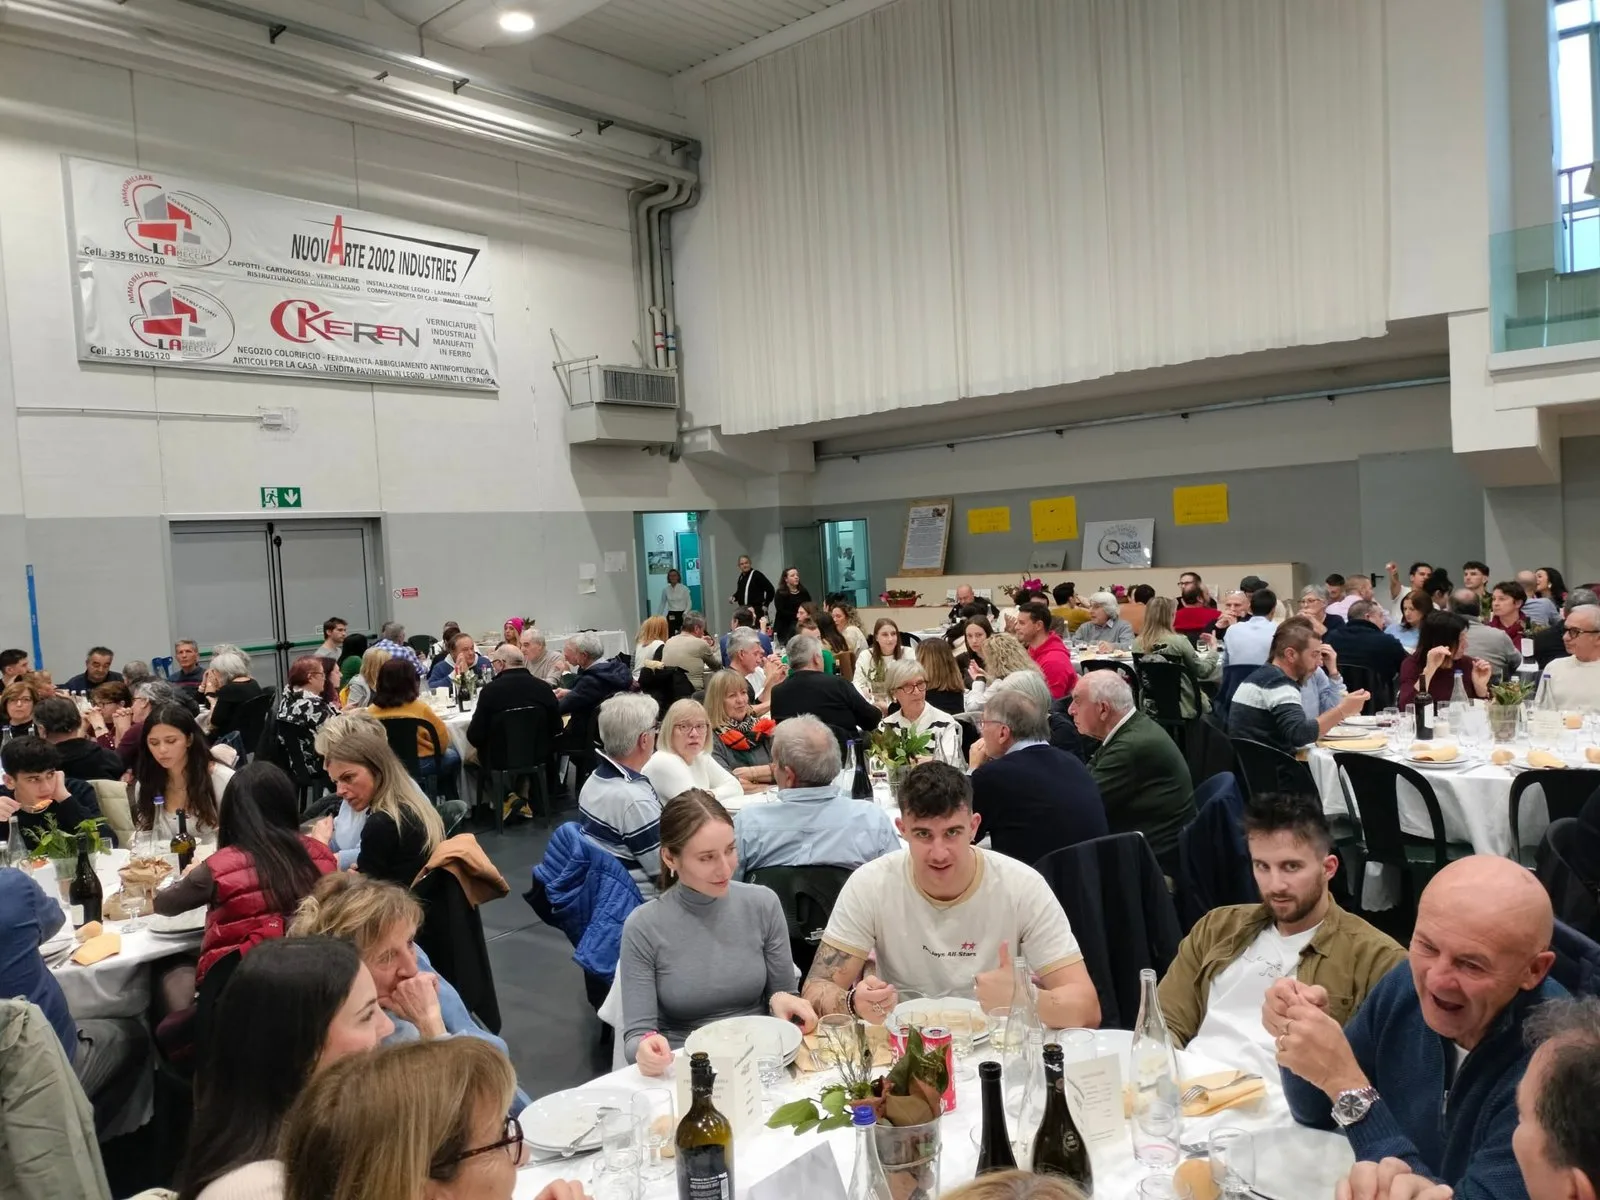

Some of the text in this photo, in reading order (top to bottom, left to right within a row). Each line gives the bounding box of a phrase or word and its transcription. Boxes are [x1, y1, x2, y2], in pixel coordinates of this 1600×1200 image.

[121, 174, 154, 207] IMMOBILIARE
[109, 250, 126, 260] 335
[128, 253, 165, 266] 8105120
[367, 246, 395, 273] 2002
[398, 251, 457, 283] INDUSTRIES
[127, 270, 159, 305] IMMOBILIARE
[227, 259, 261, 271] CAPPOTTI
[265, 265, 311, 278] CARTONGESSI
[315, 272, 360, 284] VERNICIATURE
[365, 279, 409, 292] INSTALLAZIONE
[410, 286, 430, 295] LEGNO
[434, 289, 460, 299] LAMINATI
[463, 293, 491, 303] CERAMICA
[366, 286, 416, 300] COMPRAVENDITA
[416, 293, 424, 301] DI
[424, 294, 439, 303] CASE
[442, 297, 478, 309] IMMOBILIARE
[425, 317, 478, 331] VERNICIATURE
[431, 327, 476, 340] INDUSTRIALI
[115, 347, 132, 358] 335
[134, 349, 171, 361] 8105120
[432, 337, 475, 349] MANUFATTI
[439, 348, 472, 359] IN FERRO
[232, 356, 268, 367] ARTICOLI
[269, 359, 284, 368] PER
[285, 361, 296, 369] LA
[297, 362, 317, 371] CASA
[323, 364, 355, 374] VENDITA
[402, 370, 425, 380] LEGNO
[429, 372, 460, 383] LAMINATI
[237, 345, 273, 356] NEGOZIO
[274, 349, 321, 361] COLORIFICIO
[374, 359, 429, 371] ABBIGLIAMENTO
